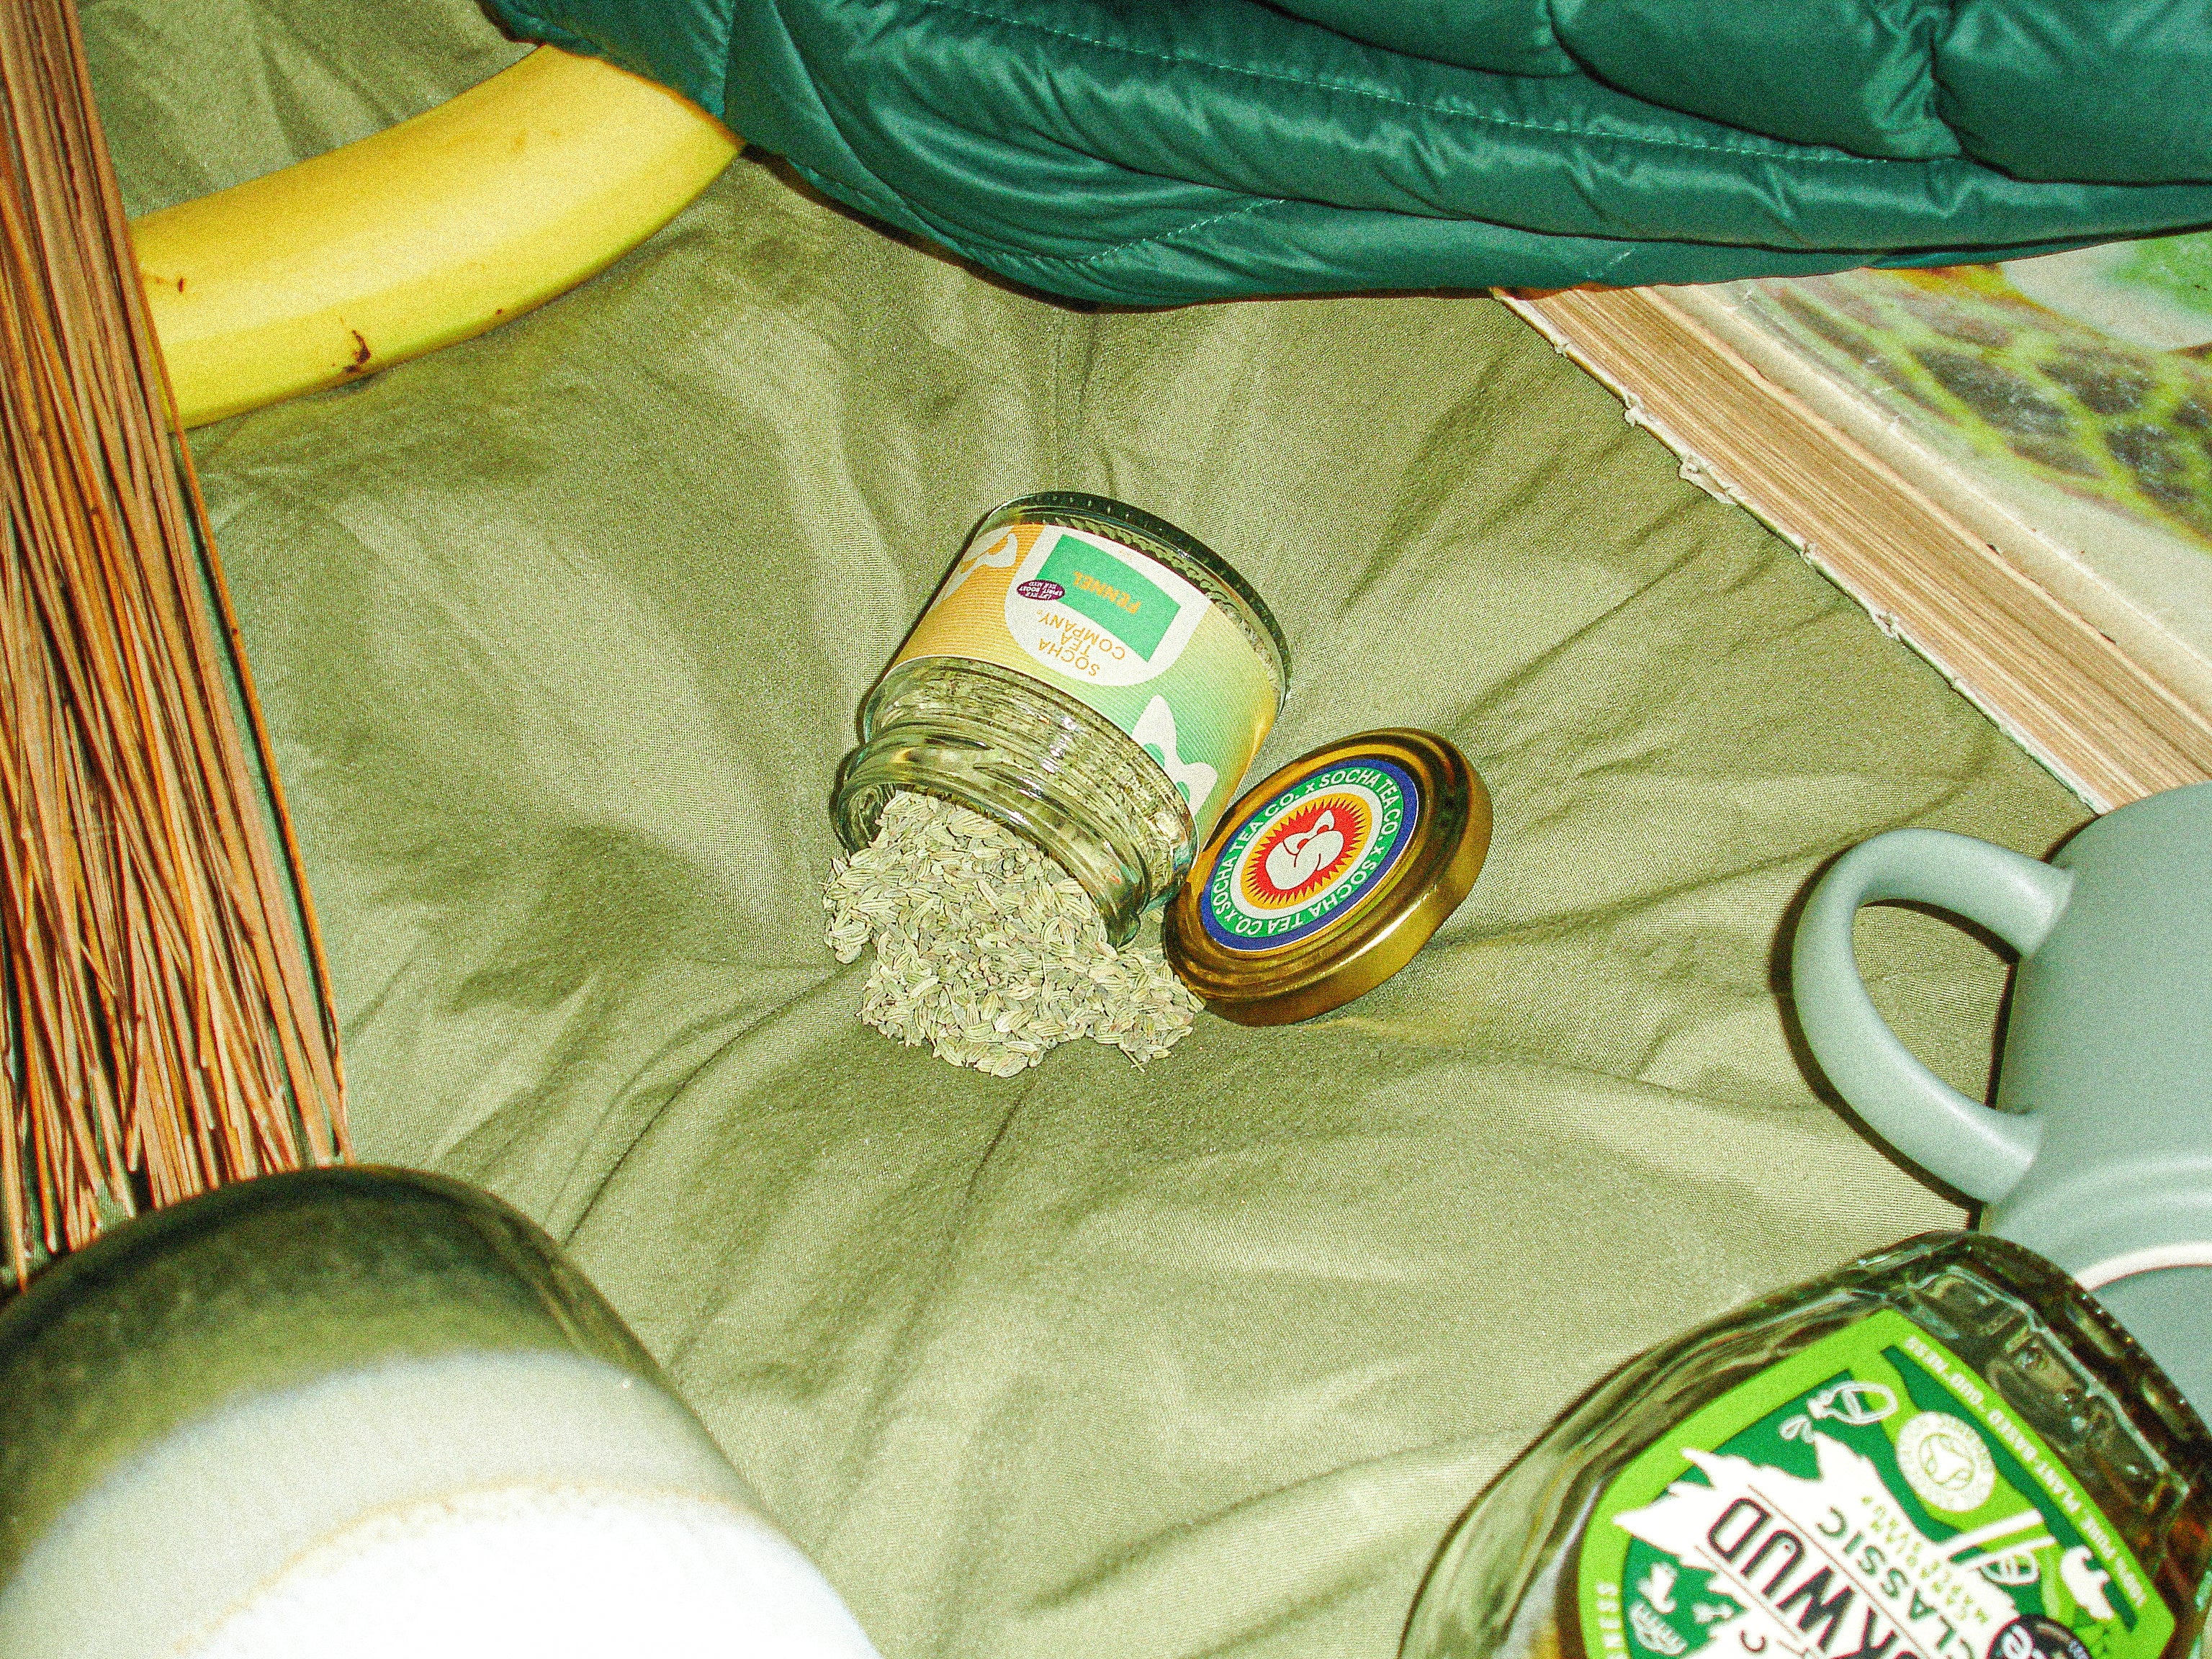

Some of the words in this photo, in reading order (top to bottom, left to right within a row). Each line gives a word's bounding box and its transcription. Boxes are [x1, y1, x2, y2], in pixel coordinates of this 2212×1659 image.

[1073, 571, 1141, 615] FENNEL
[1038, 638, 1100, 676] SOCHA
[1061, 632, 1092, 658] TEA
[1319, 769, 1377, 788] SOCHA
[1377, 778, 1399, 808] TEA
[1376, 809, 1402, 841] CO.
[1212, 858, 1235, 914] SOCHA
[1230, 819, 1264, 854] TEA
[1264, 793, 1301, 817] CO.
[1309, 860, 1378, 915] SOCHA
[1235, 915, 1261, 935] CO.
[1267, 914, 1305, 934] TEA
[1987, 1408, 2082, 1514] PLANT-BASED
[1860, 1496, 1922, 1554] SYRUP
[1870, 1520, 1968, 1620] CANADIAN
[1928, 1559, 1990, 1624] MAPLE
[2114, 1557, 2147, 1607] 100%
